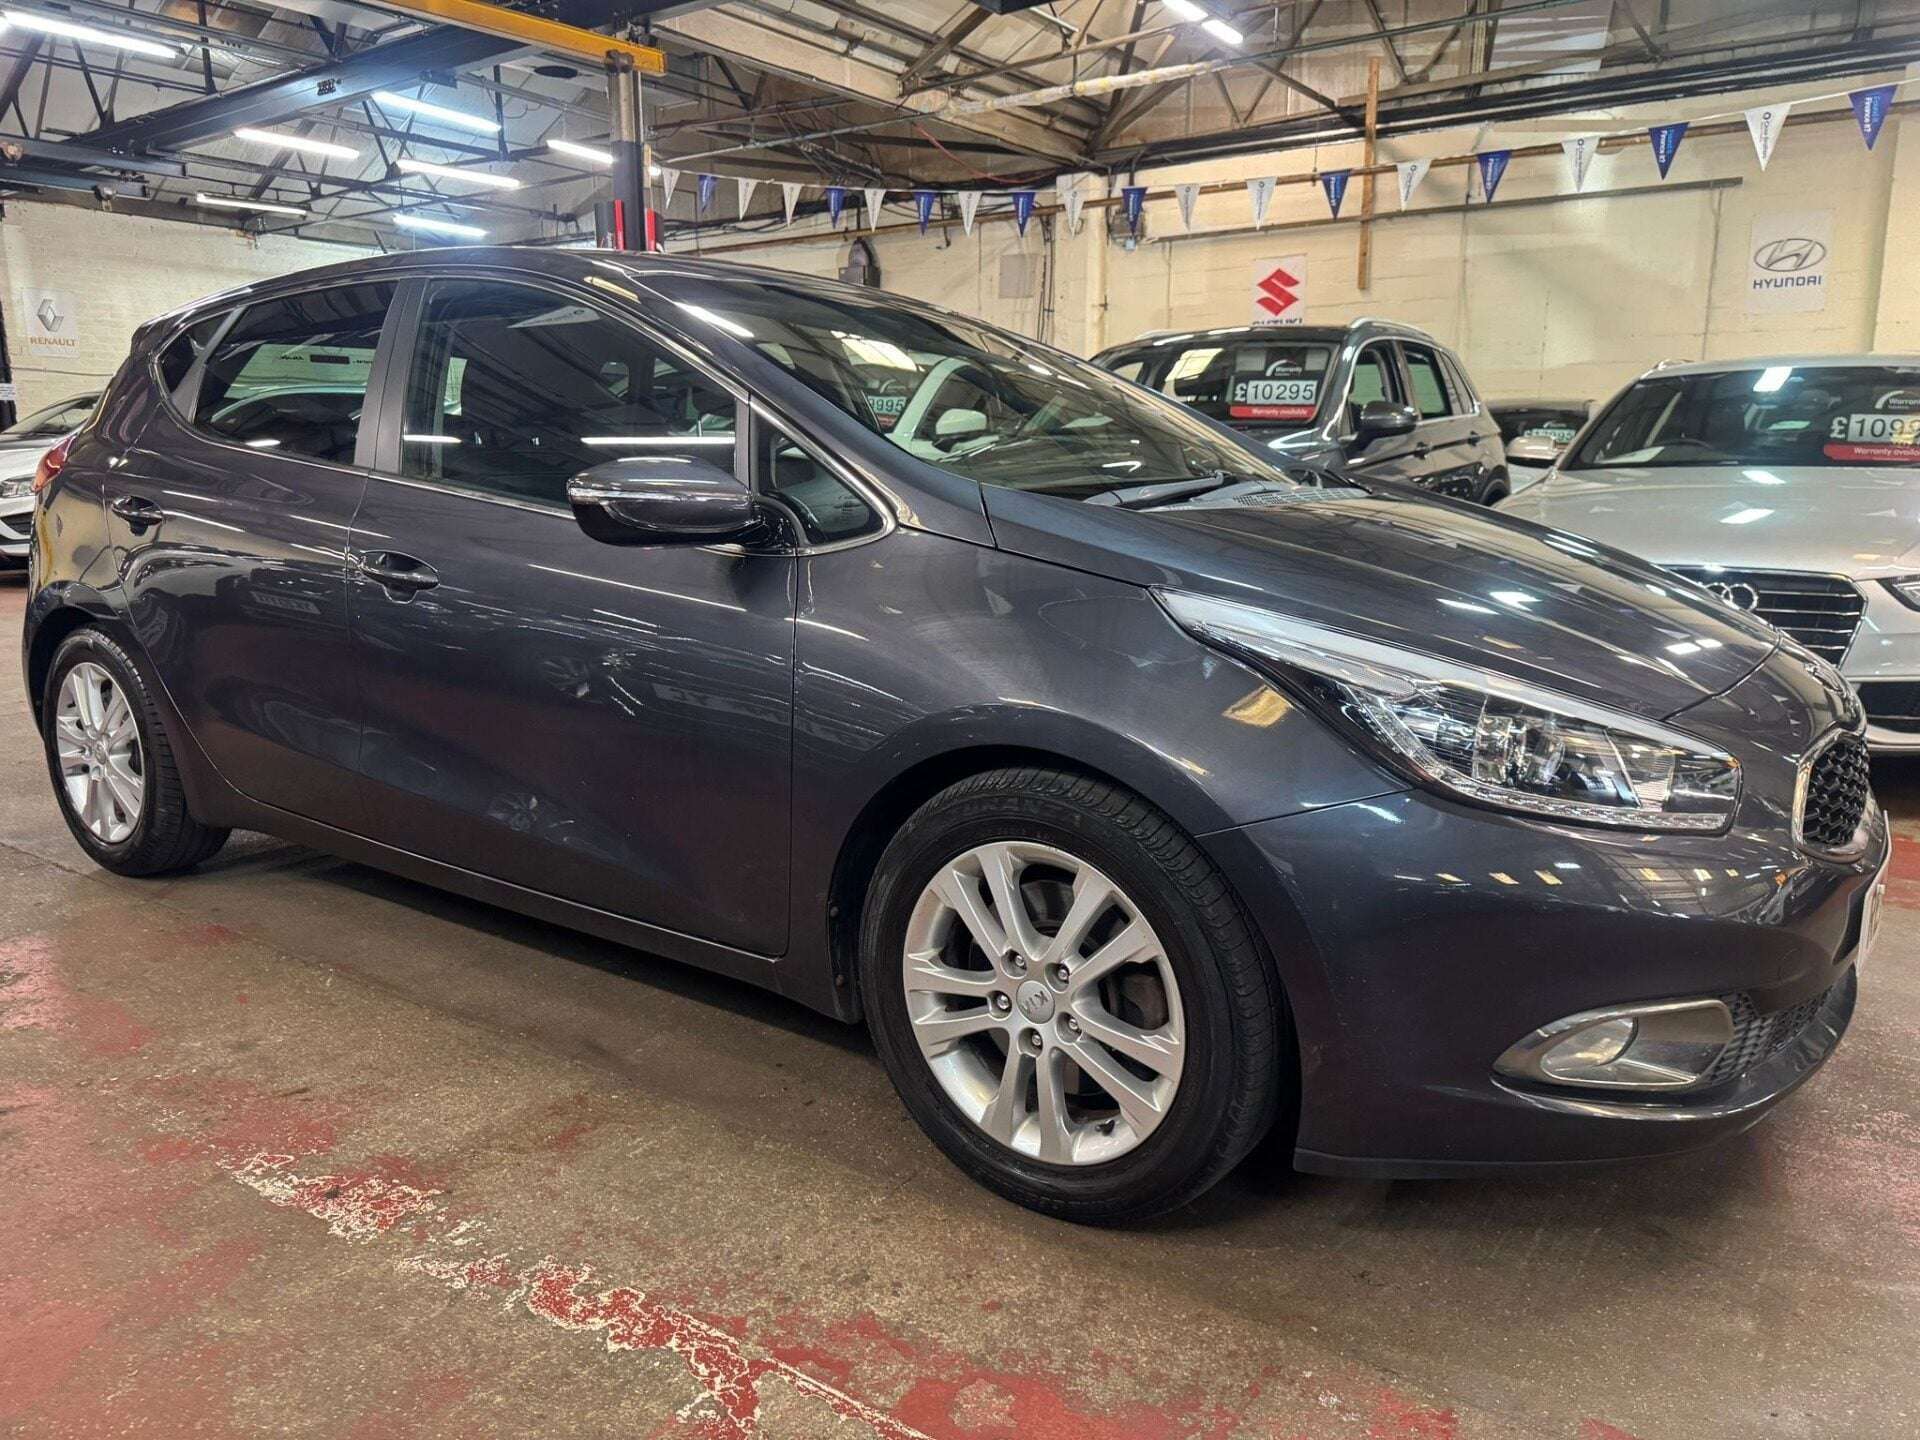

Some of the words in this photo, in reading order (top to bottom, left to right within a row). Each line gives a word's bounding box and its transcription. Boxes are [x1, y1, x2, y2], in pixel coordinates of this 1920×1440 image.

[1864, 96, 1873, 123] Finance
[1753, 275, 1823, 289] HYUNDAI
[30, 336, 76, 347] RENAULT
[1854, 447, 1891, 457] Warranty
